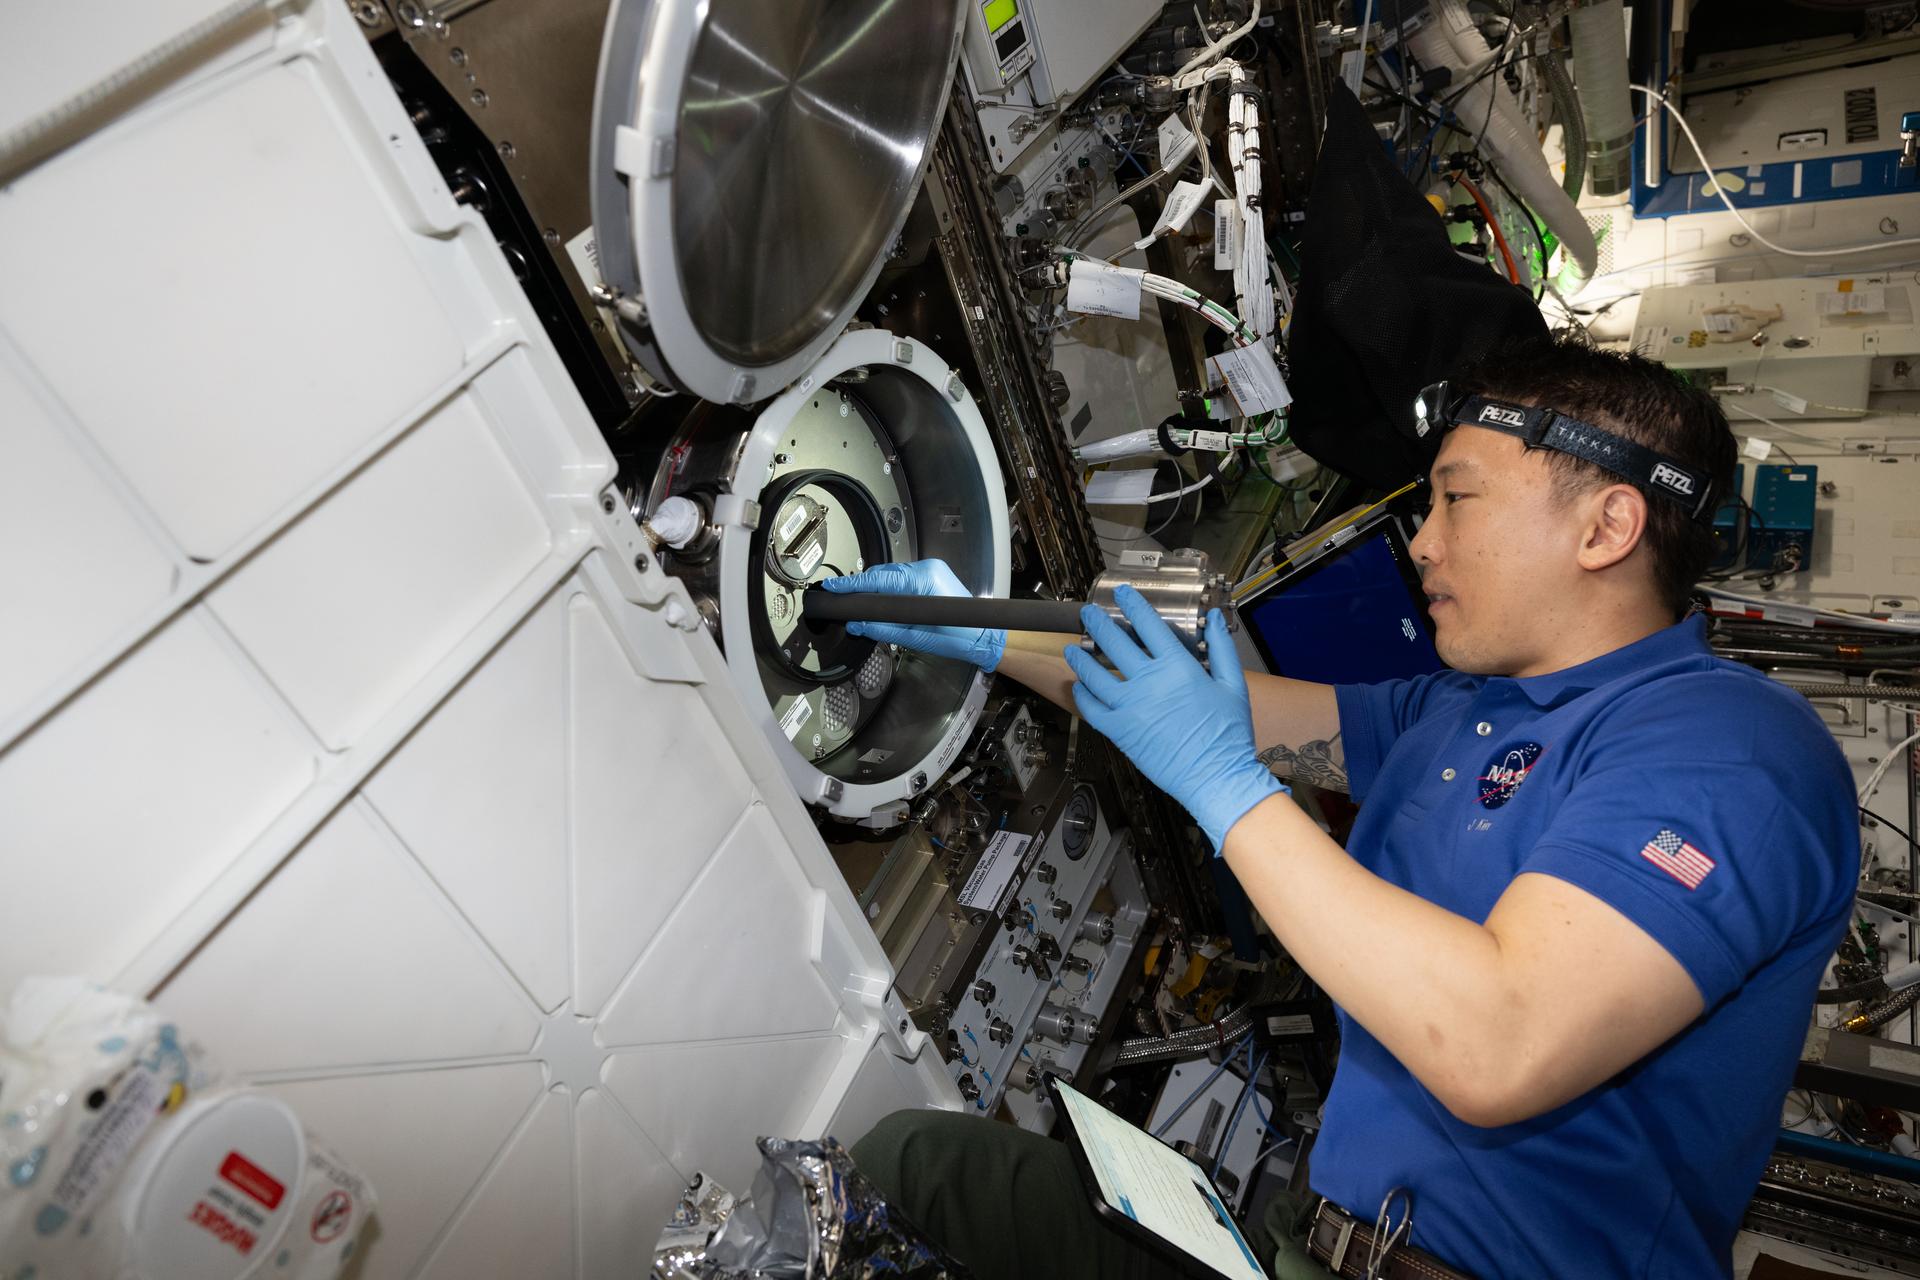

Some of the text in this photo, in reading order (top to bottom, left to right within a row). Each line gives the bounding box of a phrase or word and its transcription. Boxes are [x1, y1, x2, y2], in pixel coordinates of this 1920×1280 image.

[1479, 406, 1525, 427] PETZL
[1558, 427, 1612, 455] TIKKA
[1650, 463, 1695, 495] PETZL
[958, 860, 986, 904] MSL Vacuum Gas
[963, 870, 986, 905] System/Water
[985, 854, 996, 870] Pump
[992, 833, 1008, 854] Package
